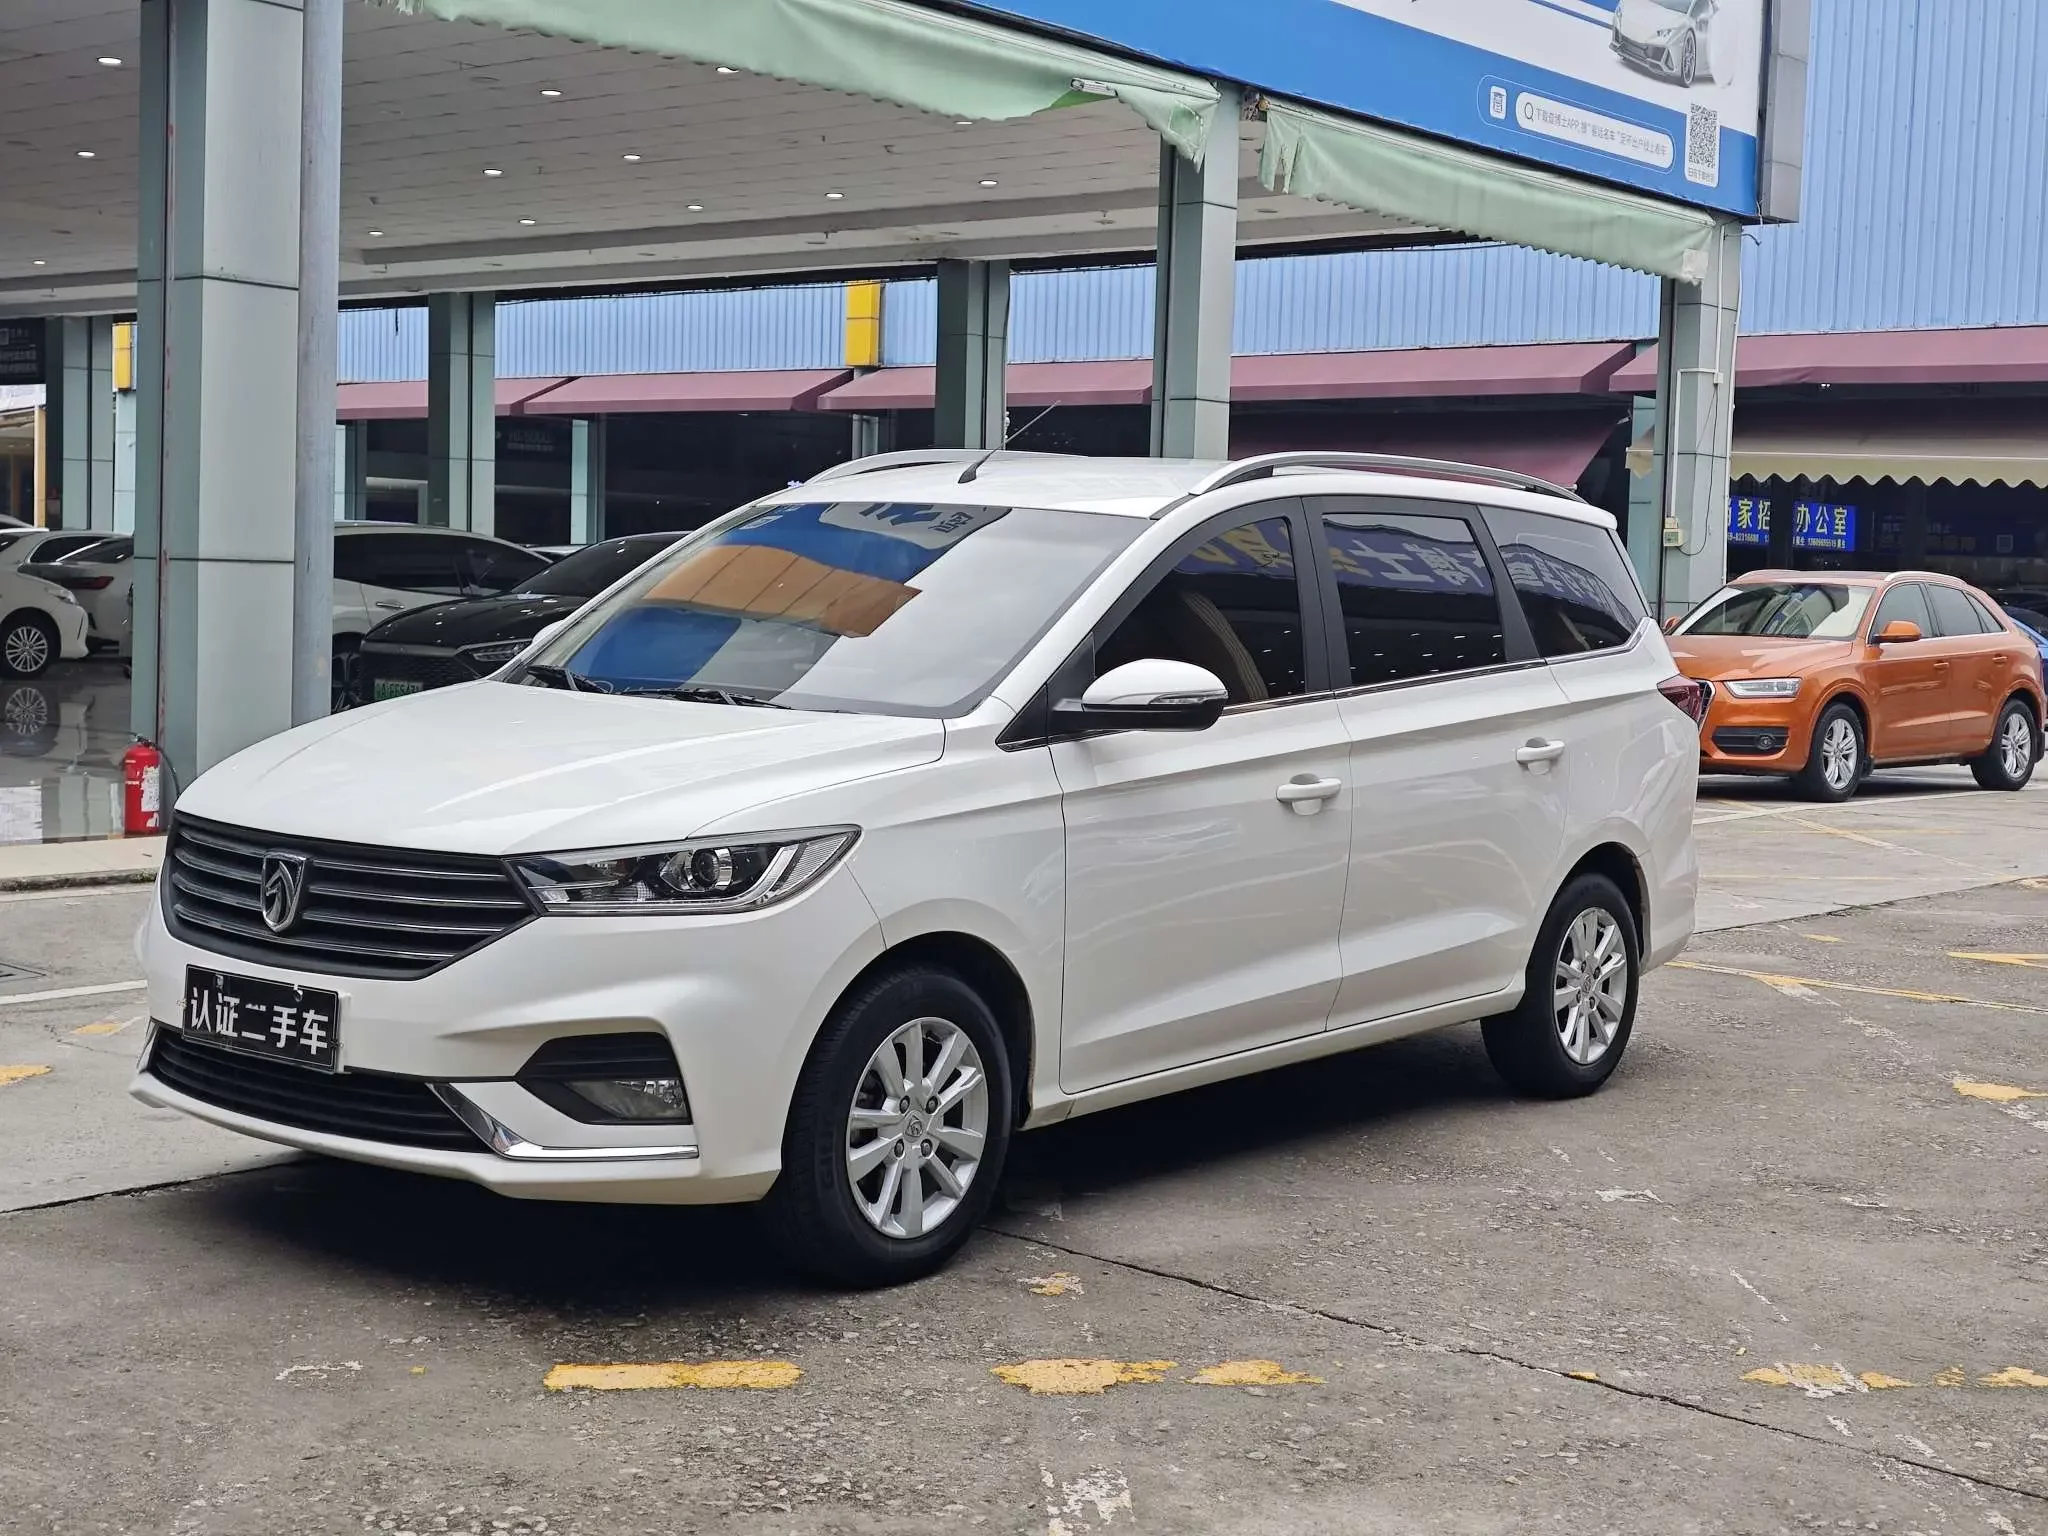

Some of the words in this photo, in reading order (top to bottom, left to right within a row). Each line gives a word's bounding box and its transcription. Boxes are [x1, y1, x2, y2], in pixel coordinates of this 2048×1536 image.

[1797, 504, 1848, 535] 办公室
[190, 986, 329, 1055] 认证二手车
